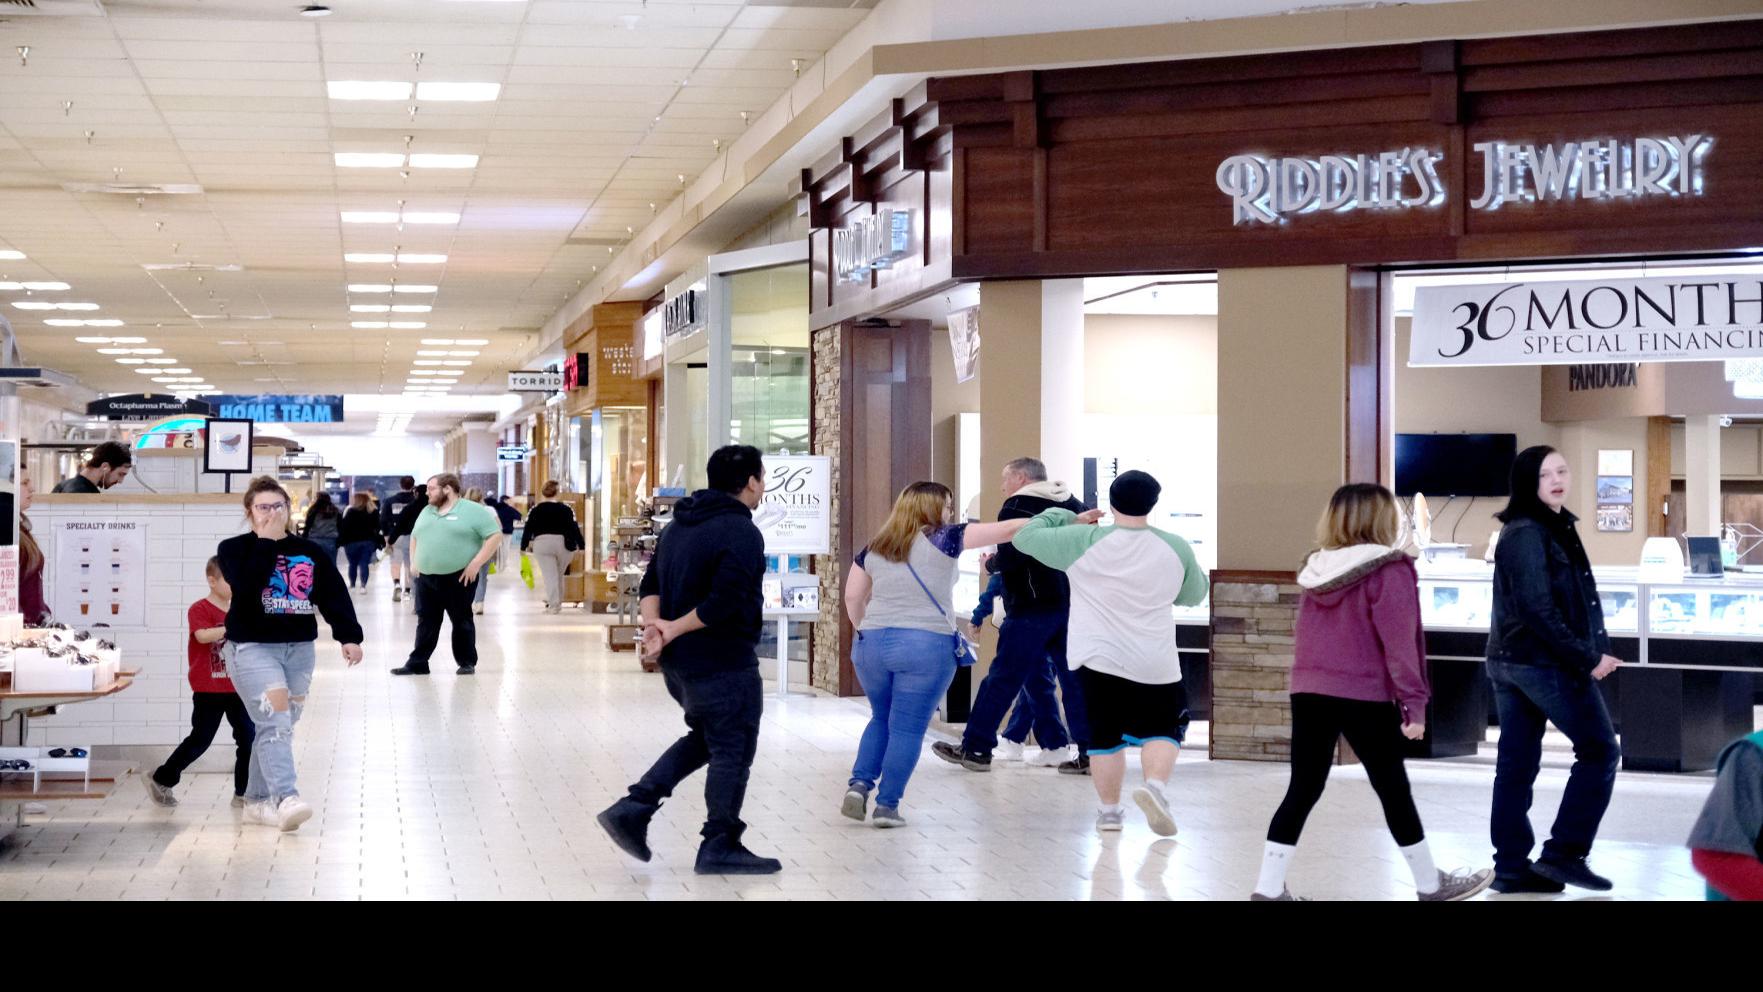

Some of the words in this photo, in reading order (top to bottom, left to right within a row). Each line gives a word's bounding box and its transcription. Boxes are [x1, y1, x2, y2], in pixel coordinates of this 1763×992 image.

[1216, 146, 1442, 226] RIDDLE'S
[1470, 135, 1711, 210] JEWELRY
[1438, 283, 1524, 358] 36
[1524, 334, 1627, 355] SPECIAL
[1638, 330, 1763, 353] FINANCI
[511, 377, 561, 386] TORRID
[1568, 362, 1637, 392] PANDORA
[108, 401, 158, 410] Octapharma
[219, 403, 276, 422] HOME
[280, 403, 332, 423] TEAM
[764, 465, 812, 493] 36
[66, 522, 105, 530] SPECIALTY
[108, 522, 136, 530] DRINKS
